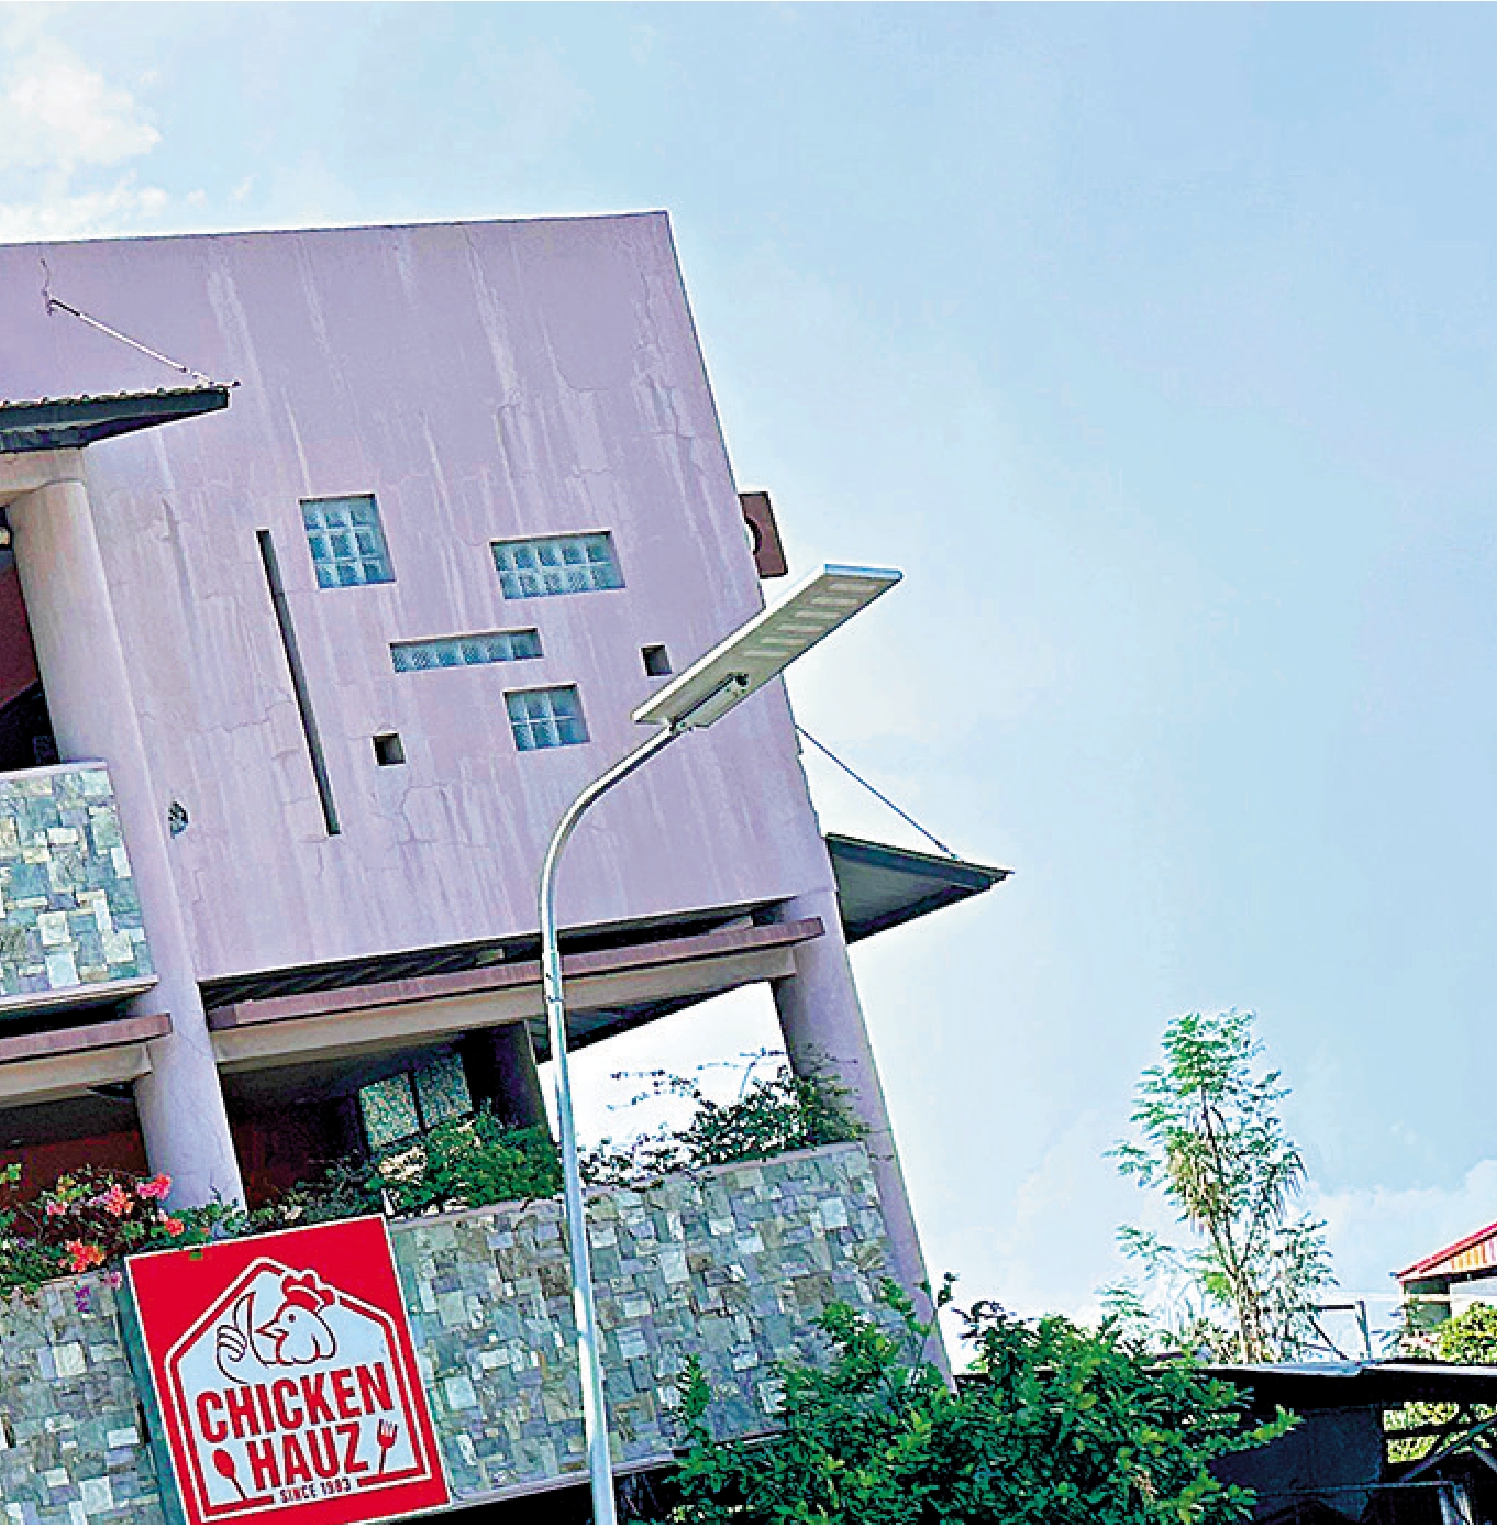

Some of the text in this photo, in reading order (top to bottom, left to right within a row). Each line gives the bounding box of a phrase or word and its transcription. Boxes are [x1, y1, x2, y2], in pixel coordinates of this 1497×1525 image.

[197, 1362, 393, 1443] CHICKEN
[246, 1421, 369, 1491] HAUZ
[280, 1482, 316, 1503] SINCE
